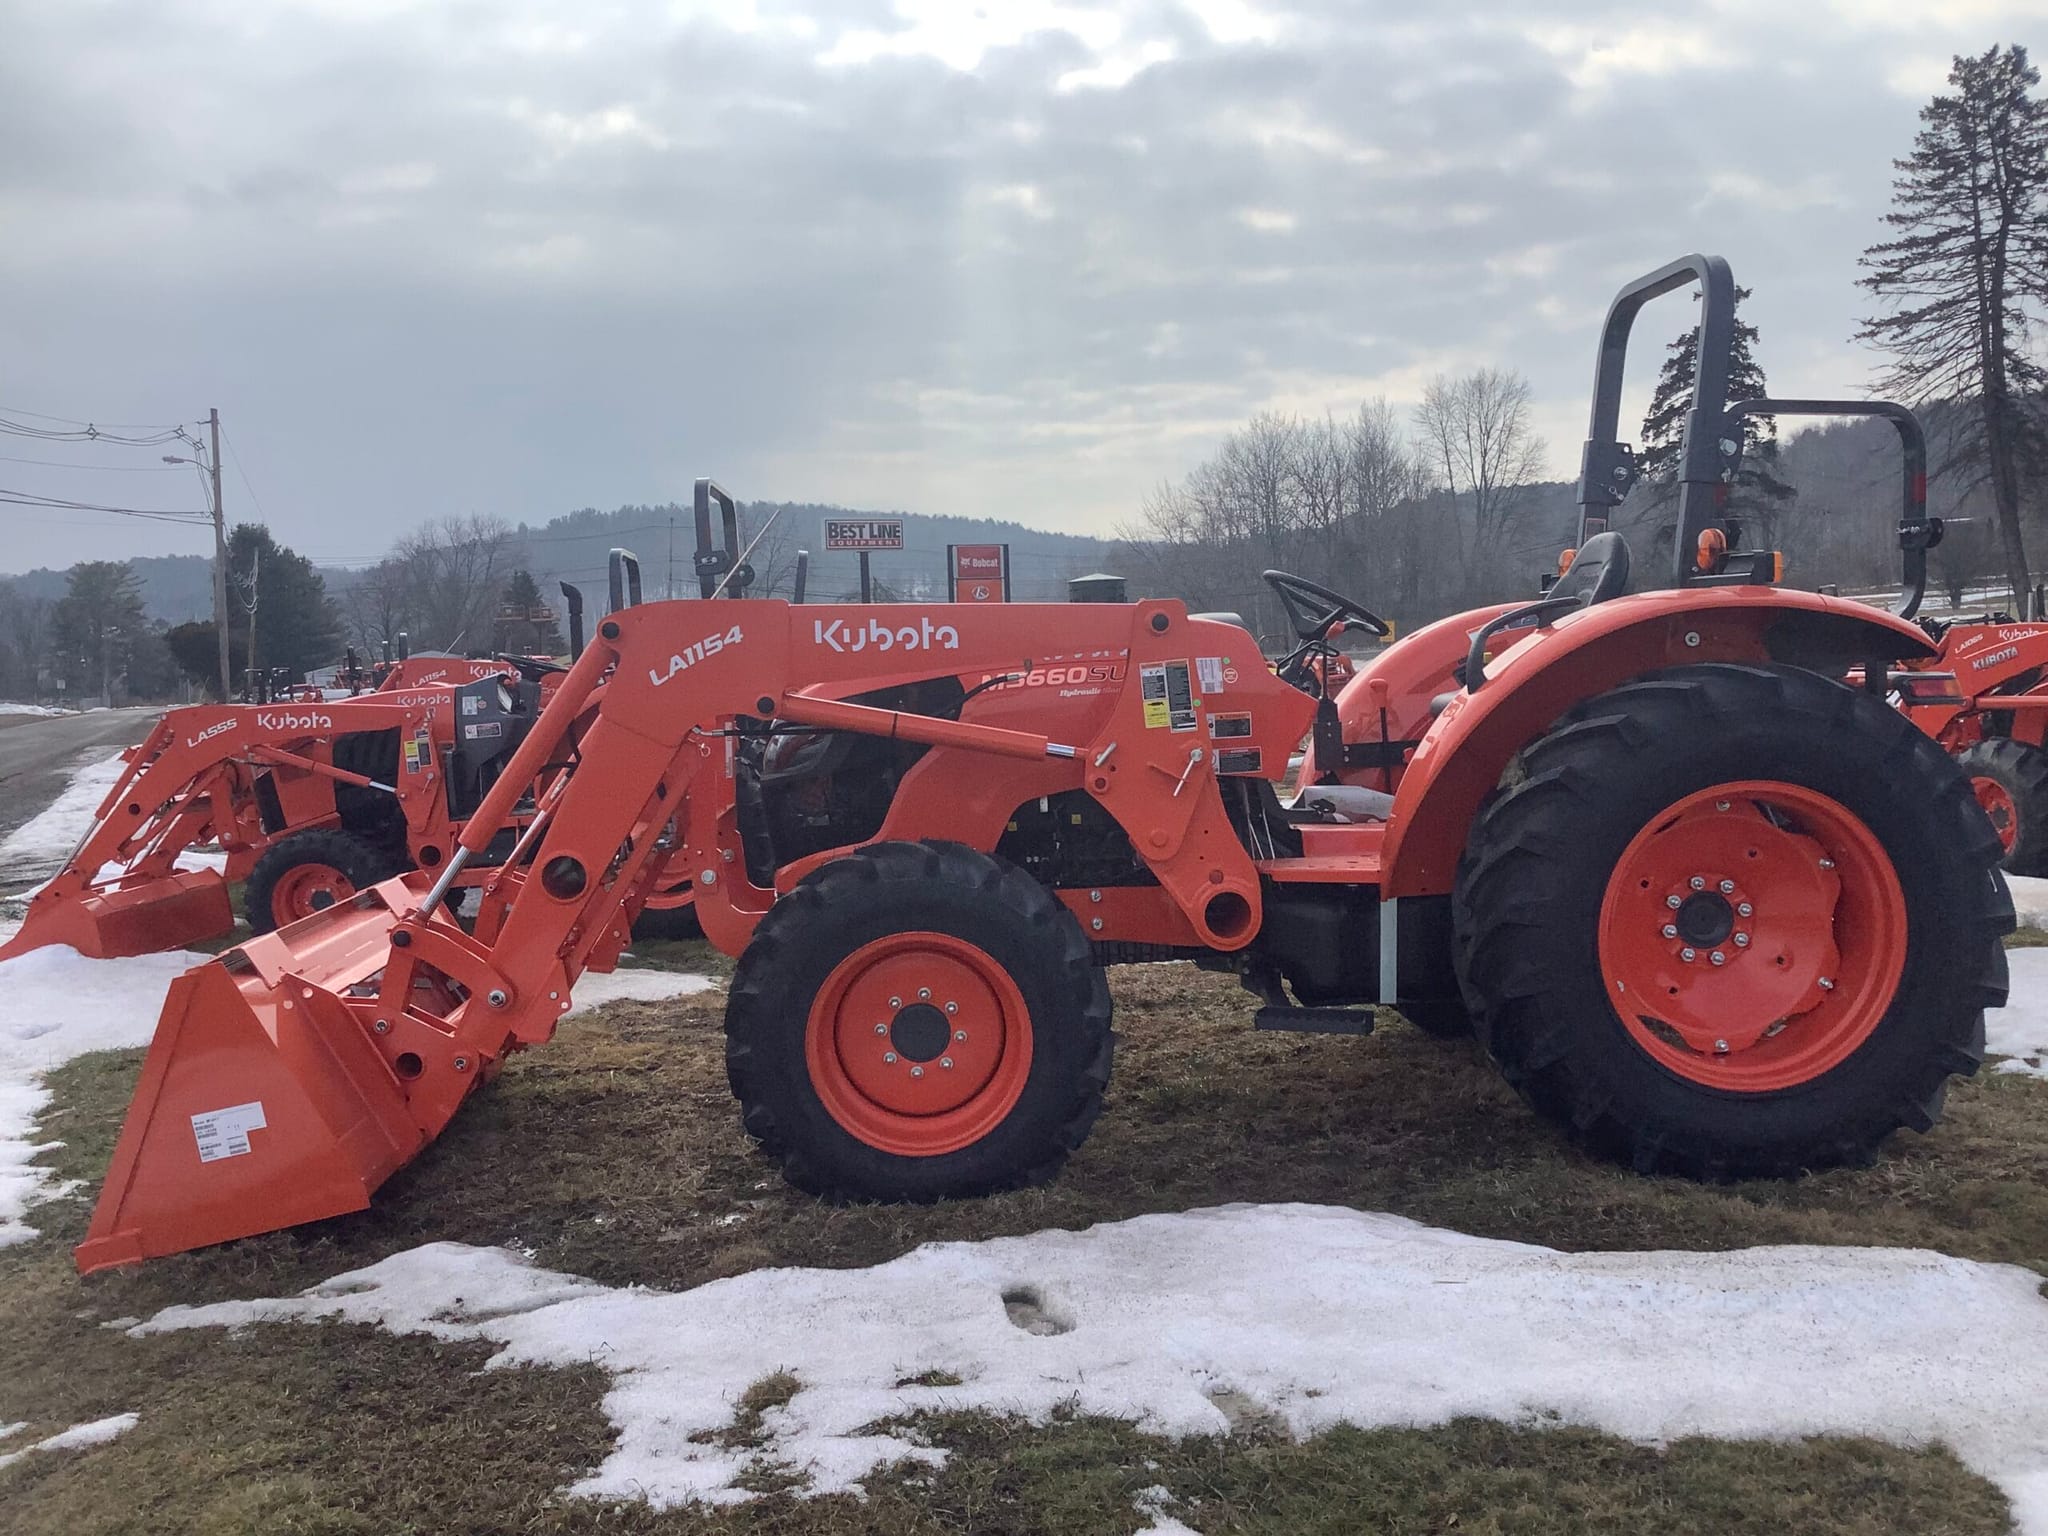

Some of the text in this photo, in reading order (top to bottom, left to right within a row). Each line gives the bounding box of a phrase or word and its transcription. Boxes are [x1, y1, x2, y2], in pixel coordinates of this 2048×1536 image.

[972, 558, 998, 568] Bobcat
[814, 616, 959, 652] Kubota
[649, 625, 744, 686] LA1154
[1972, 647, 2018, 669] KUBOTA
[411, 669, 447, 688] LA1154
[470, 665, 522, 682] Kubta
[396, 693, 451, 706] Kubota
[1059, 687, 1102, 698] Hydraulic
[257, 711, 332, 730] Kubota
[186, 718, 238, 748] LA555
